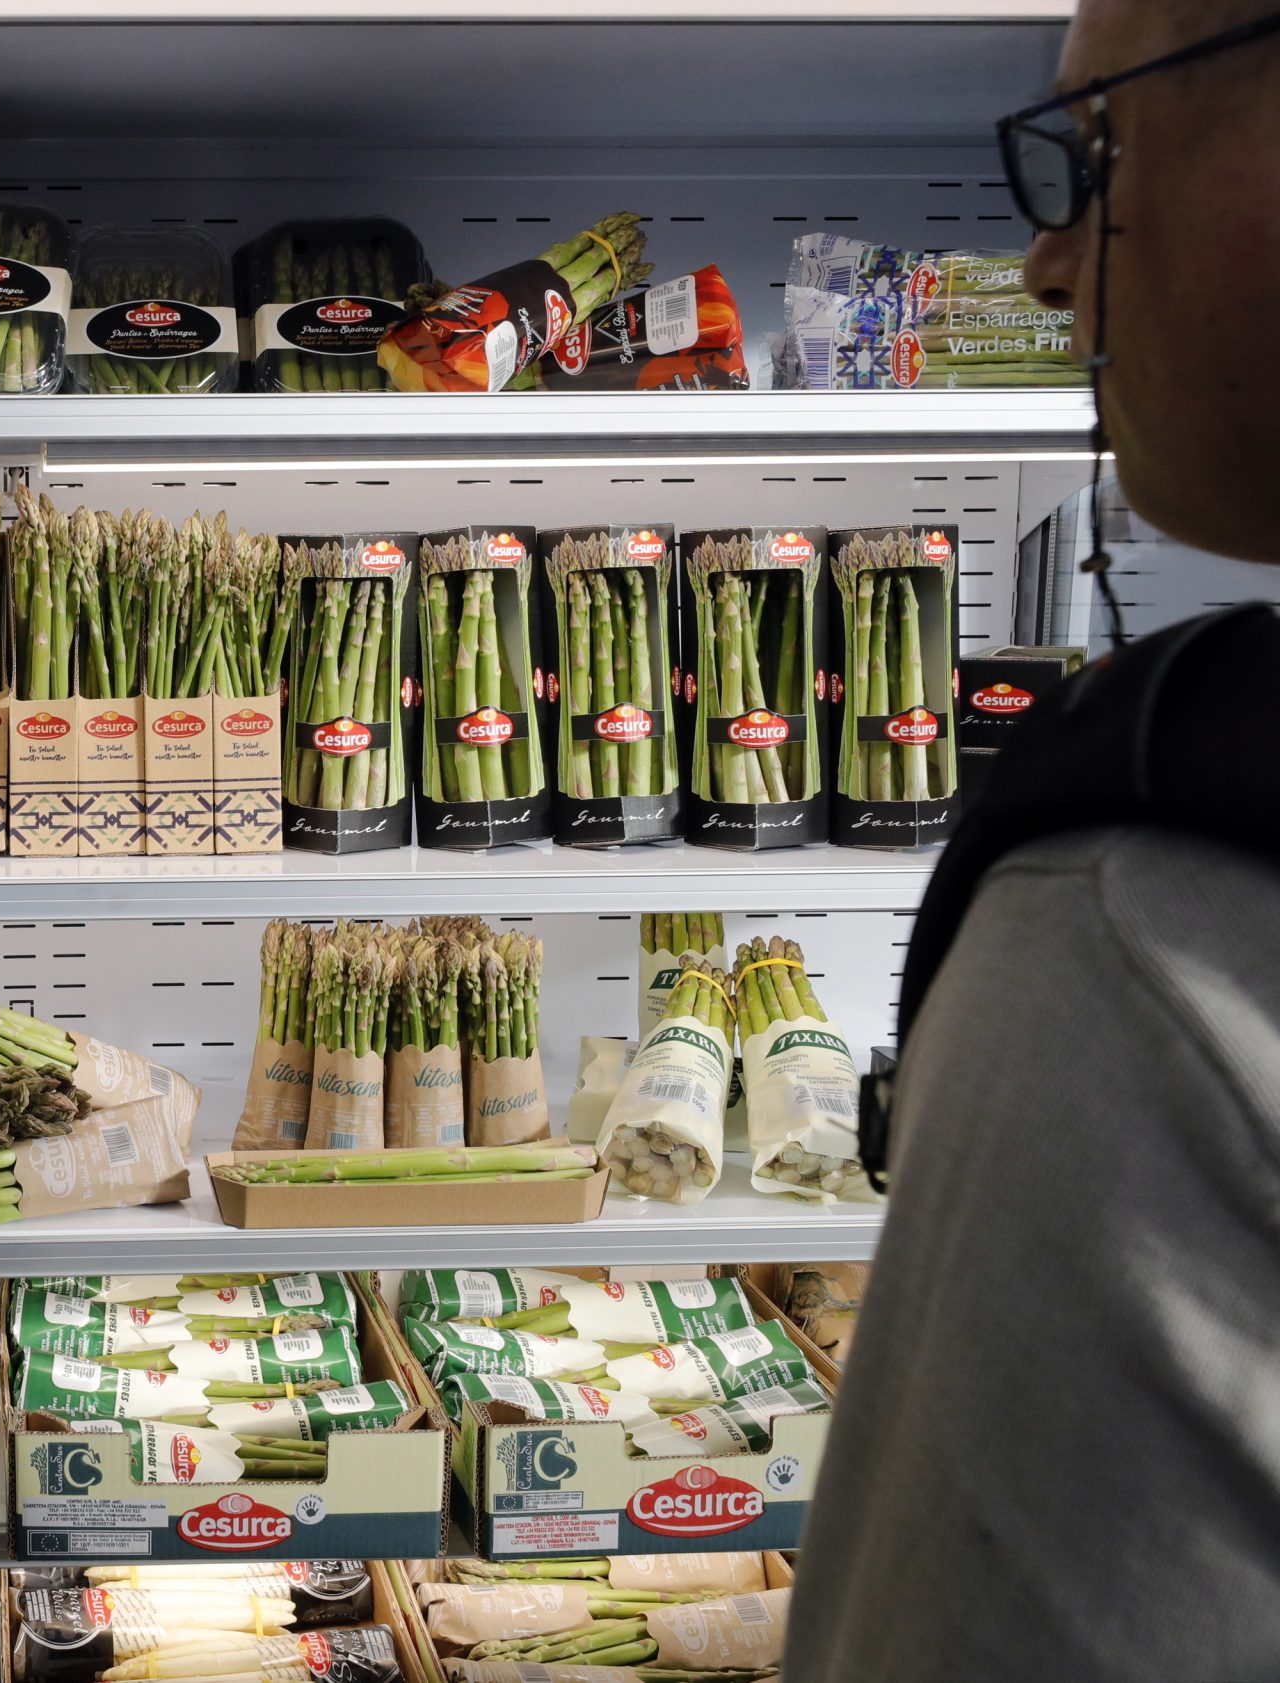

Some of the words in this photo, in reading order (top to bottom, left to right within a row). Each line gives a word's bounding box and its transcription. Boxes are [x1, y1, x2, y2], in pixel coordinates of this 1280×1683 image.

[125, 310, 181, 322] Cesurca
[316, 306, 372, 319] Cesurca
[949, 308, 1074, 332] Espárragos
[111, 329, 142, 338] Puntas
[301, 325, 333, 334] Puntas
[340, 325, 385, 334] Espárrago
[947, 336, 1027, 355] Verdes
[1035, 332, 1072, 351] Fin
[899, 334, 914, 384] Cesurca
[487, 539, 522, 557] Cesurca
[626, 540, 664, 555] Cesurca
[771, 541, 811, 557] Cesurca
[924, 541, 949, 556] Cesurca
[361, 550, 401, 565] Cesurca
[972, 692, 1030, 707] Cesurca
[18, 721, 67, 735] Cesurca
[86, 720, 134, 733] Cesurca
[154, 720, 201, 733] Cesurca
[222, 718, 270, 731] Cesurca
[458, 720, 513, 739] Cesurca
[596, 717, 651, 735] Cesurca
[729, 723, 787, 740] Cesurca
[886, 720, 938, 738] Cesurca
[313, 730, 369, 748] Cesurca
[435, 808, 531, 832] Gourmet
[571, 806, 665, 827] Gourmet
[702, 812, 805, 830] Gourmet
[851, 809, 948, 830] Gourmet
[290, 817, 388, 836] Gourmet
[265, 1058, 313, 1084] Vitasa
[413, 1063, 463, 1089] Vitasa
[317, 1067, 382, 1098] Vitasana
[478, 1087, 538, 1118] Vitasana
[176, 1433, 191, 1483] Cesurca
[631, 1487, 764, 1521] Cesurca
[181, 1510, 293, 1539] Cesurca
[90, 1588, 107, 1631] esurca
